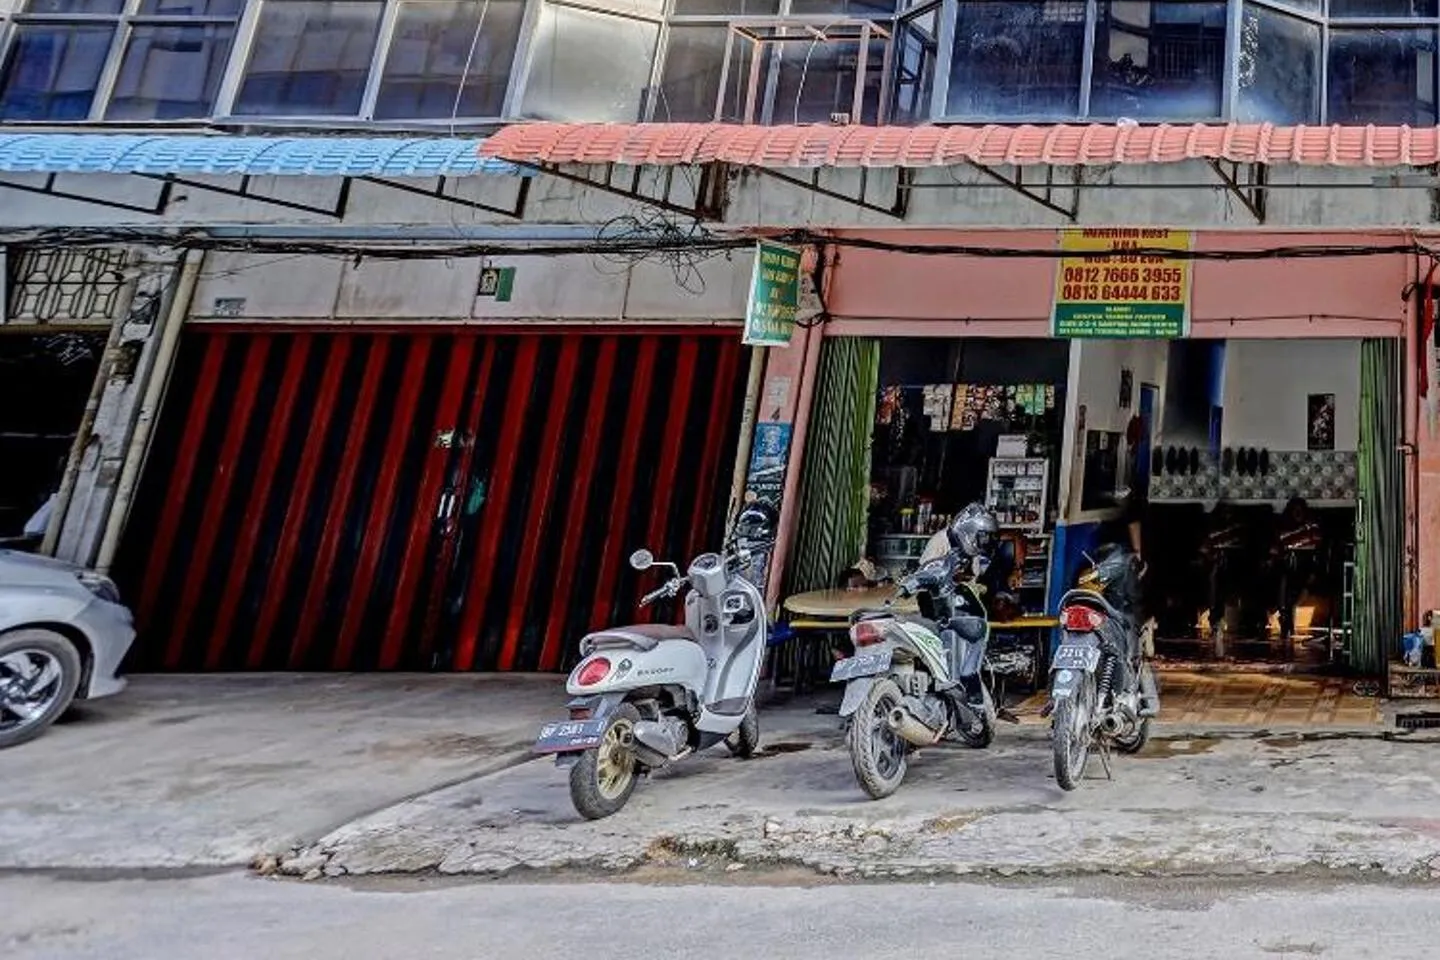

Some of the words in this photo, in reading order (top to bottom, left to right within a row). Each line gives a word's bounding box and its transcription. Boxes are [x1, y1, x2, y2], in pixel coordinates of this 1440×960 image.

[1064, 267, 1099, 282] 0812
[1103, 267, 1139, 282] 7666
[1142, 268, 1181, 282] 3955
[1063, 285, 1098, 300] 0813
[1151, 286, 1180, 300] 633
